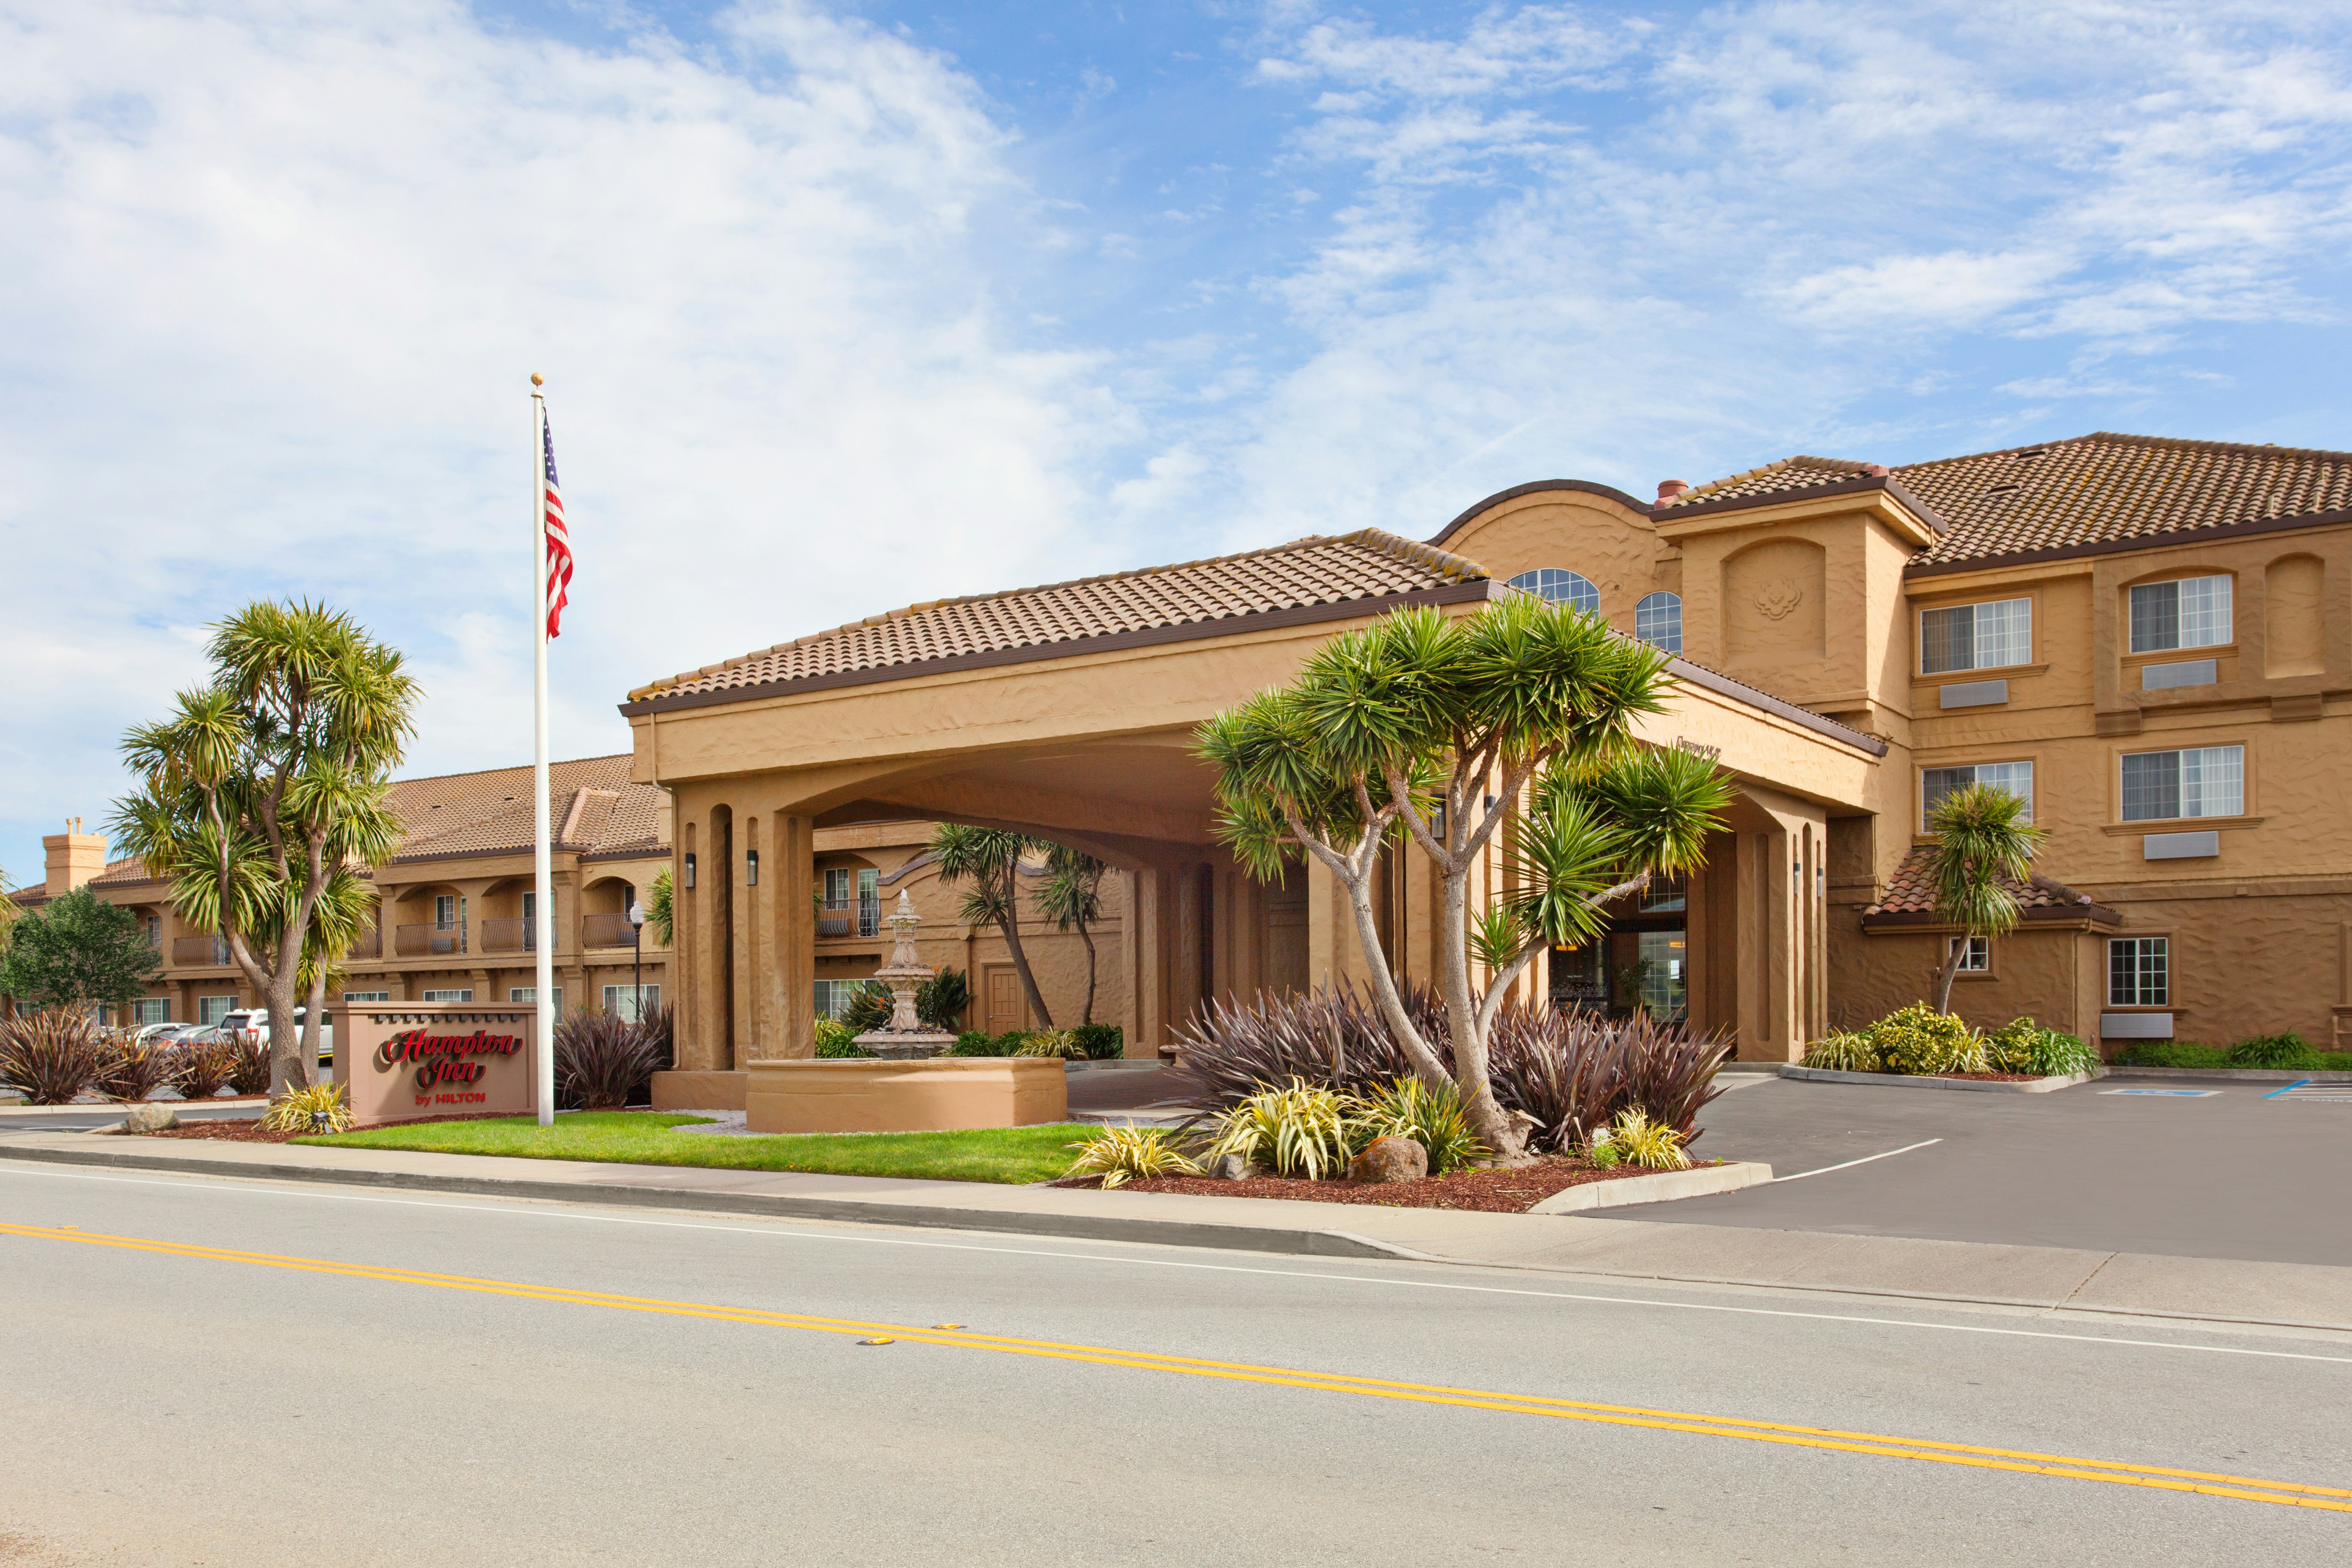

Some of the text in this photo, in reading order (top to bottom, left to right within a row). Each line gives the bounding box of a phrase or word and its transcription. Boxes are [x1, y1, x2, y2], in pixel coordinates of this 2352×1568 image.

[382, 1028, 523, 1063] Hampton
[417, 1055, 486, 1089] Inn
[416, 1092, 486, 1107] by HILTON
